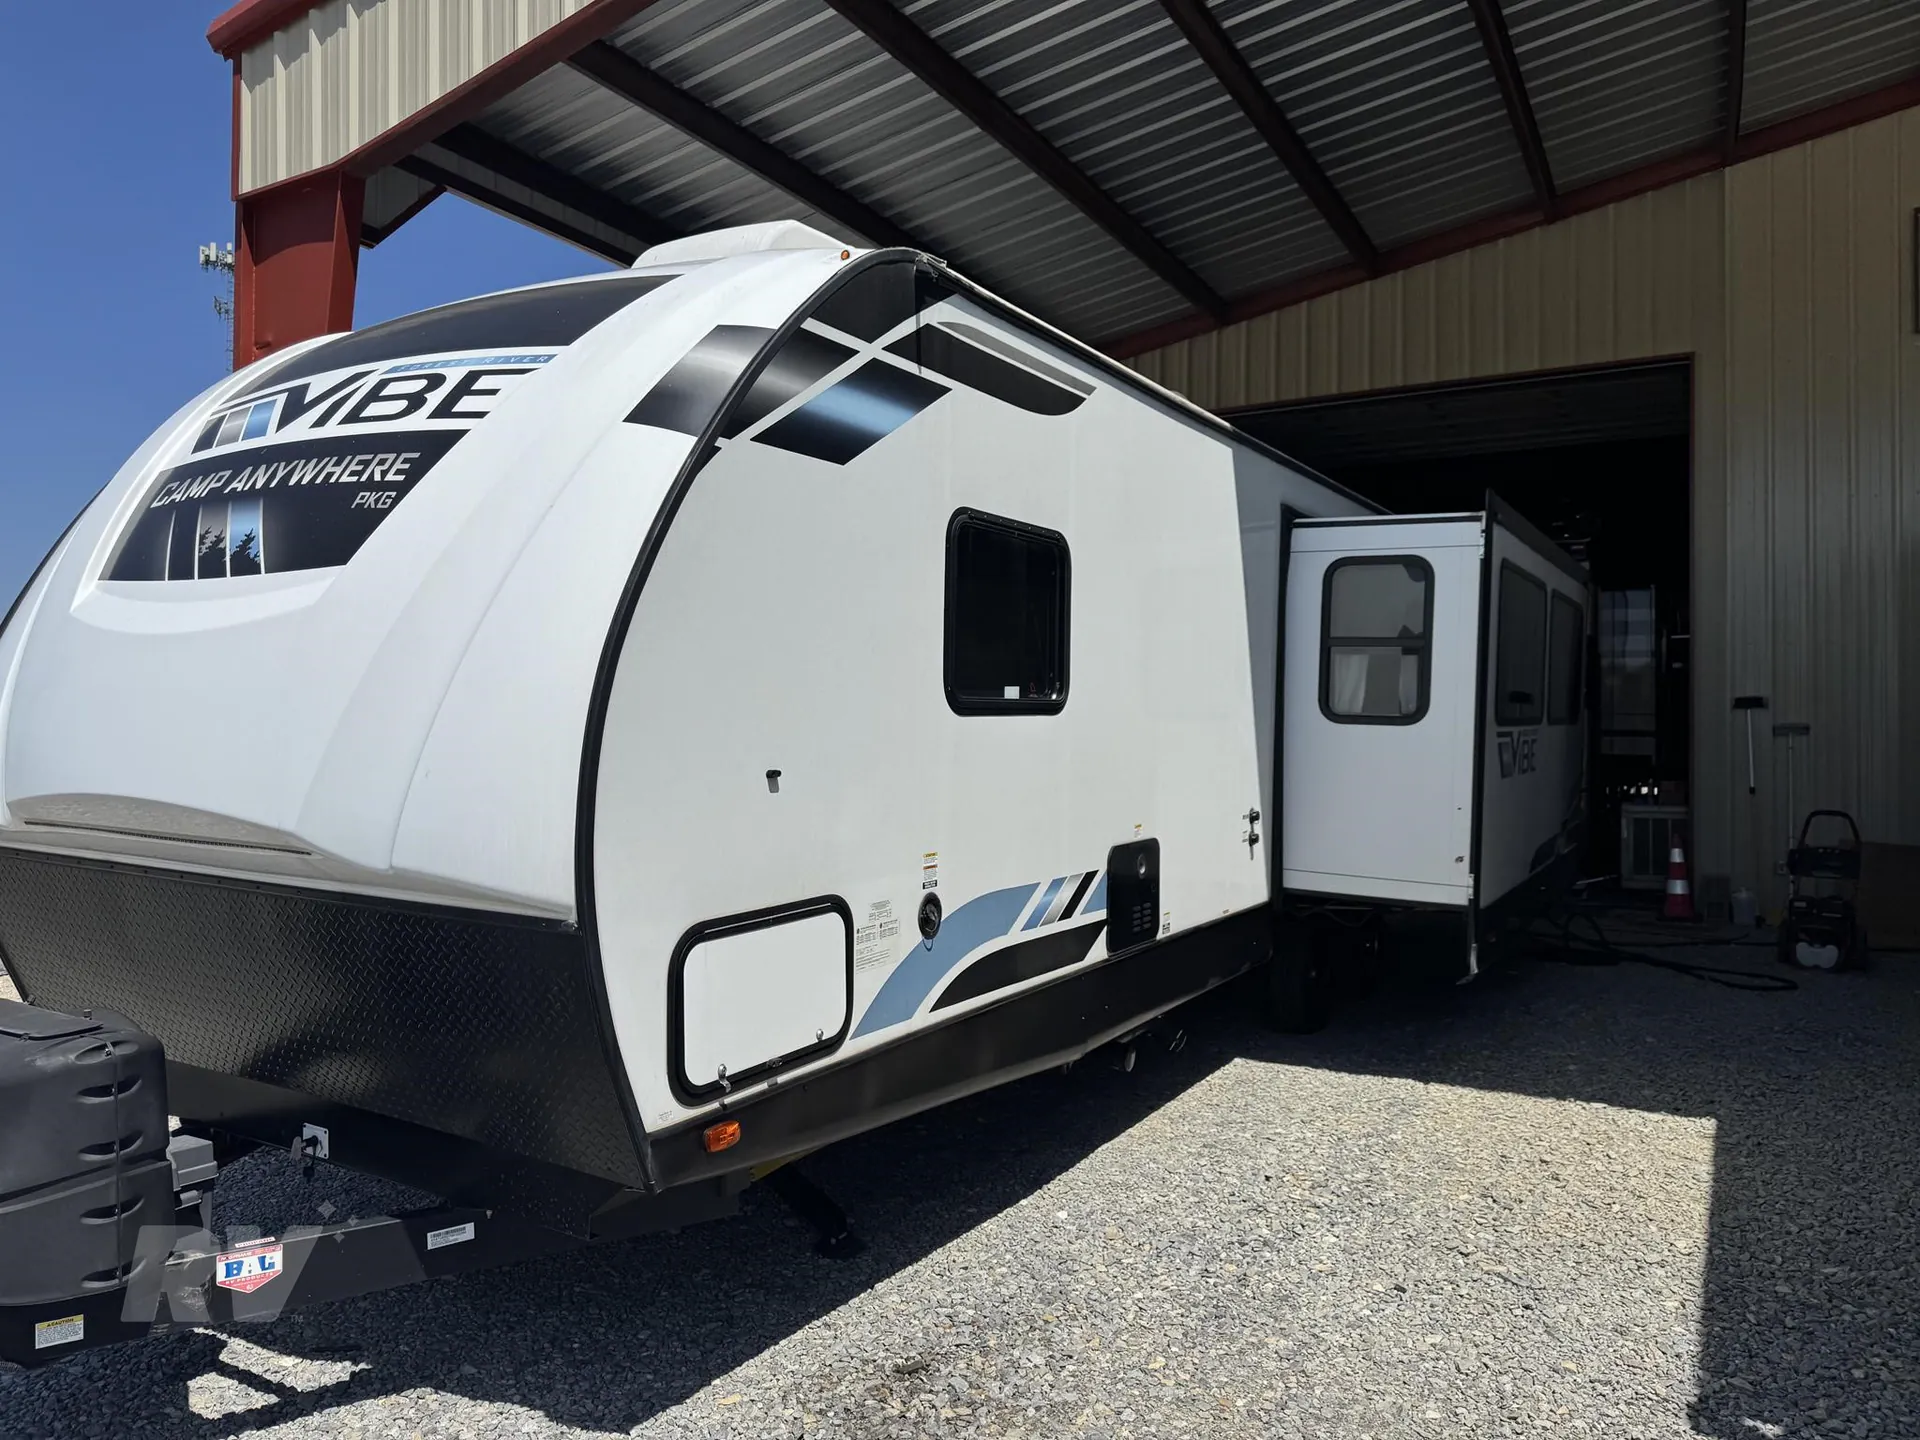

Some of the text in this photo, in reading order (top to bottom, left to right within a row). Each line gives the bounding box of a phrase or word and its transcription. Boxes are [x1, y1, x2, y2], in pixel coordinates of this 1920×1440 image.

[397, 355, 550, 372] FOREST RIVER
[274, 368, 542, 435] VIBE
[150, 452, 421, 509] CAMP ANYWHERE
[351, 491, 397, 509] PKG
[236, 1272, 275, 1283] PRODUCTS
